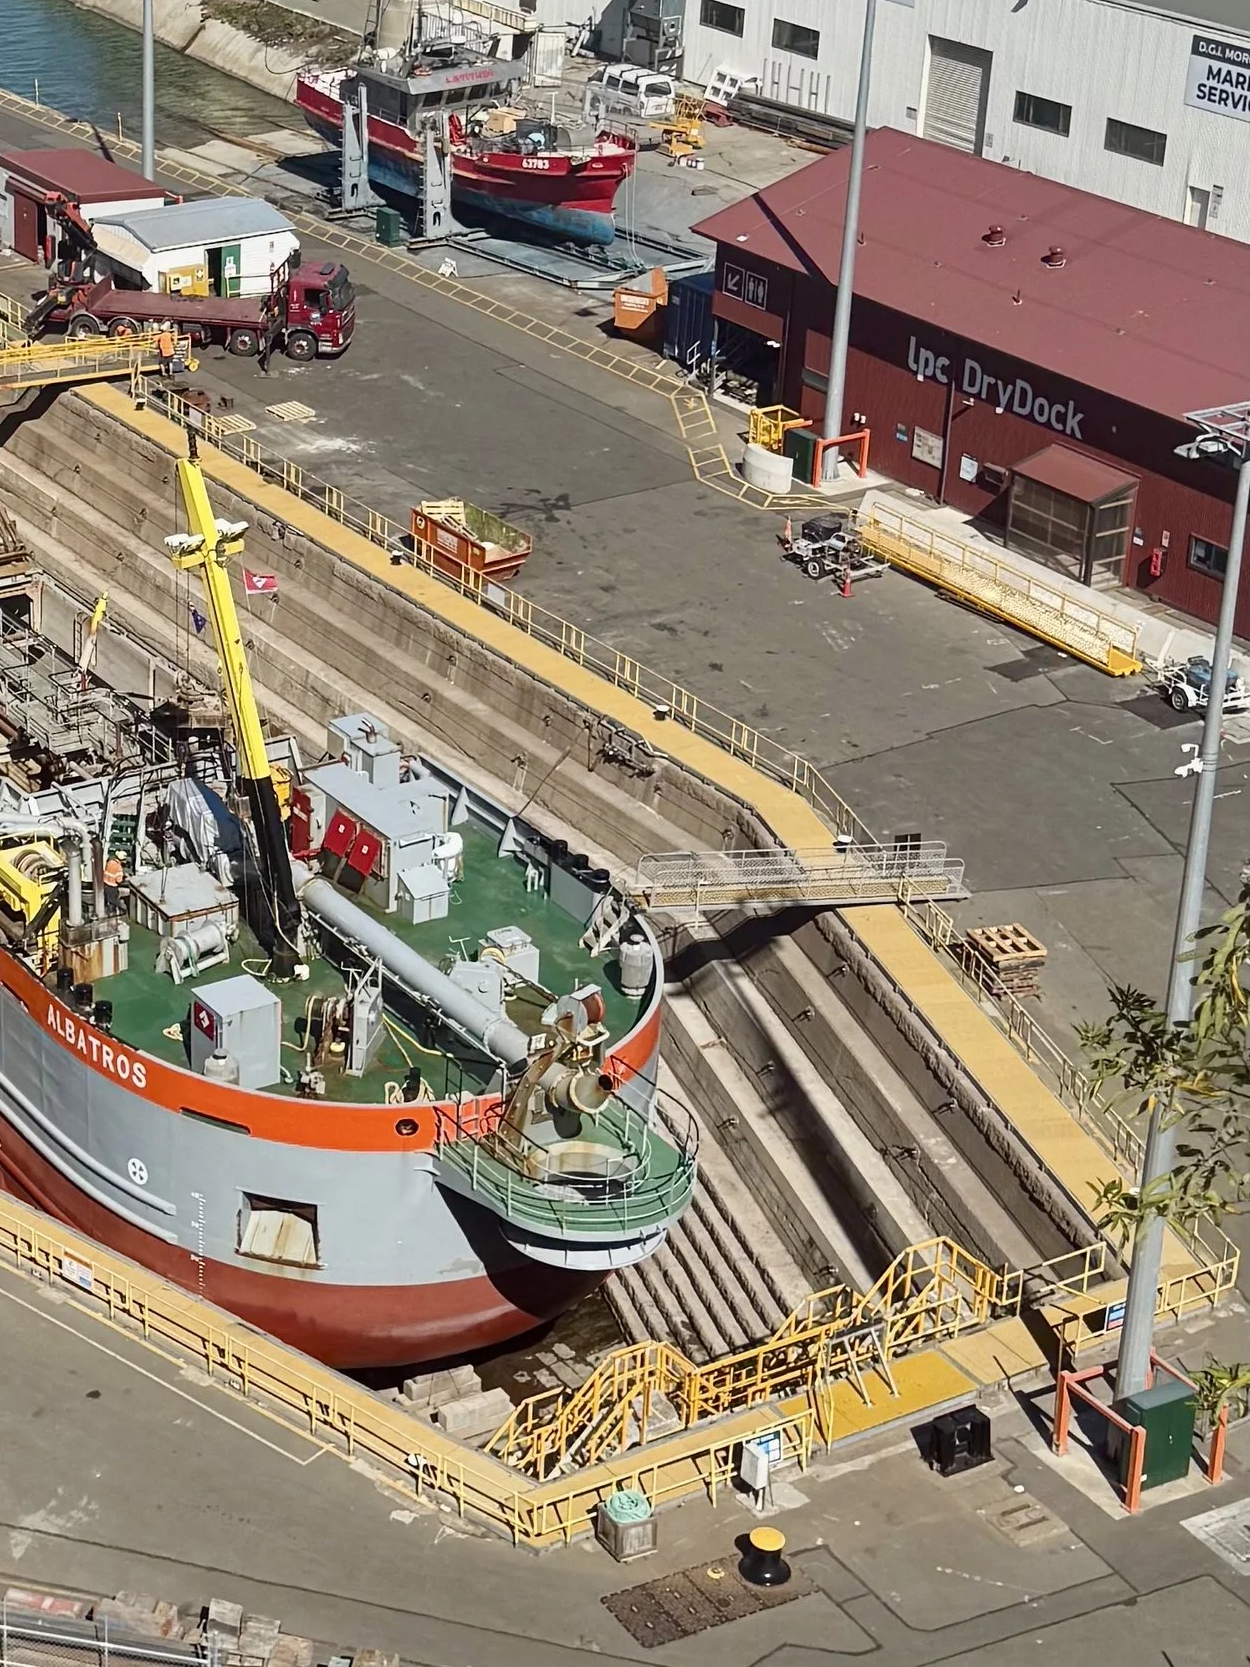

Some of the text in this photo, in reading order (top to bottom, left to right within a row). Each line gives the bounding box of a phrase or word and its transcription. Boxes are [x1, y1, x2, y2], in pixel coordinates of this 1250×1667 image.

[1225, 48, 1250, 65] MOR
[1196, 82, 1250, 112] SERVI
[962, 358, 1085, 440] DryDock
[47, 1003, 147, 1088] ALBATROS
